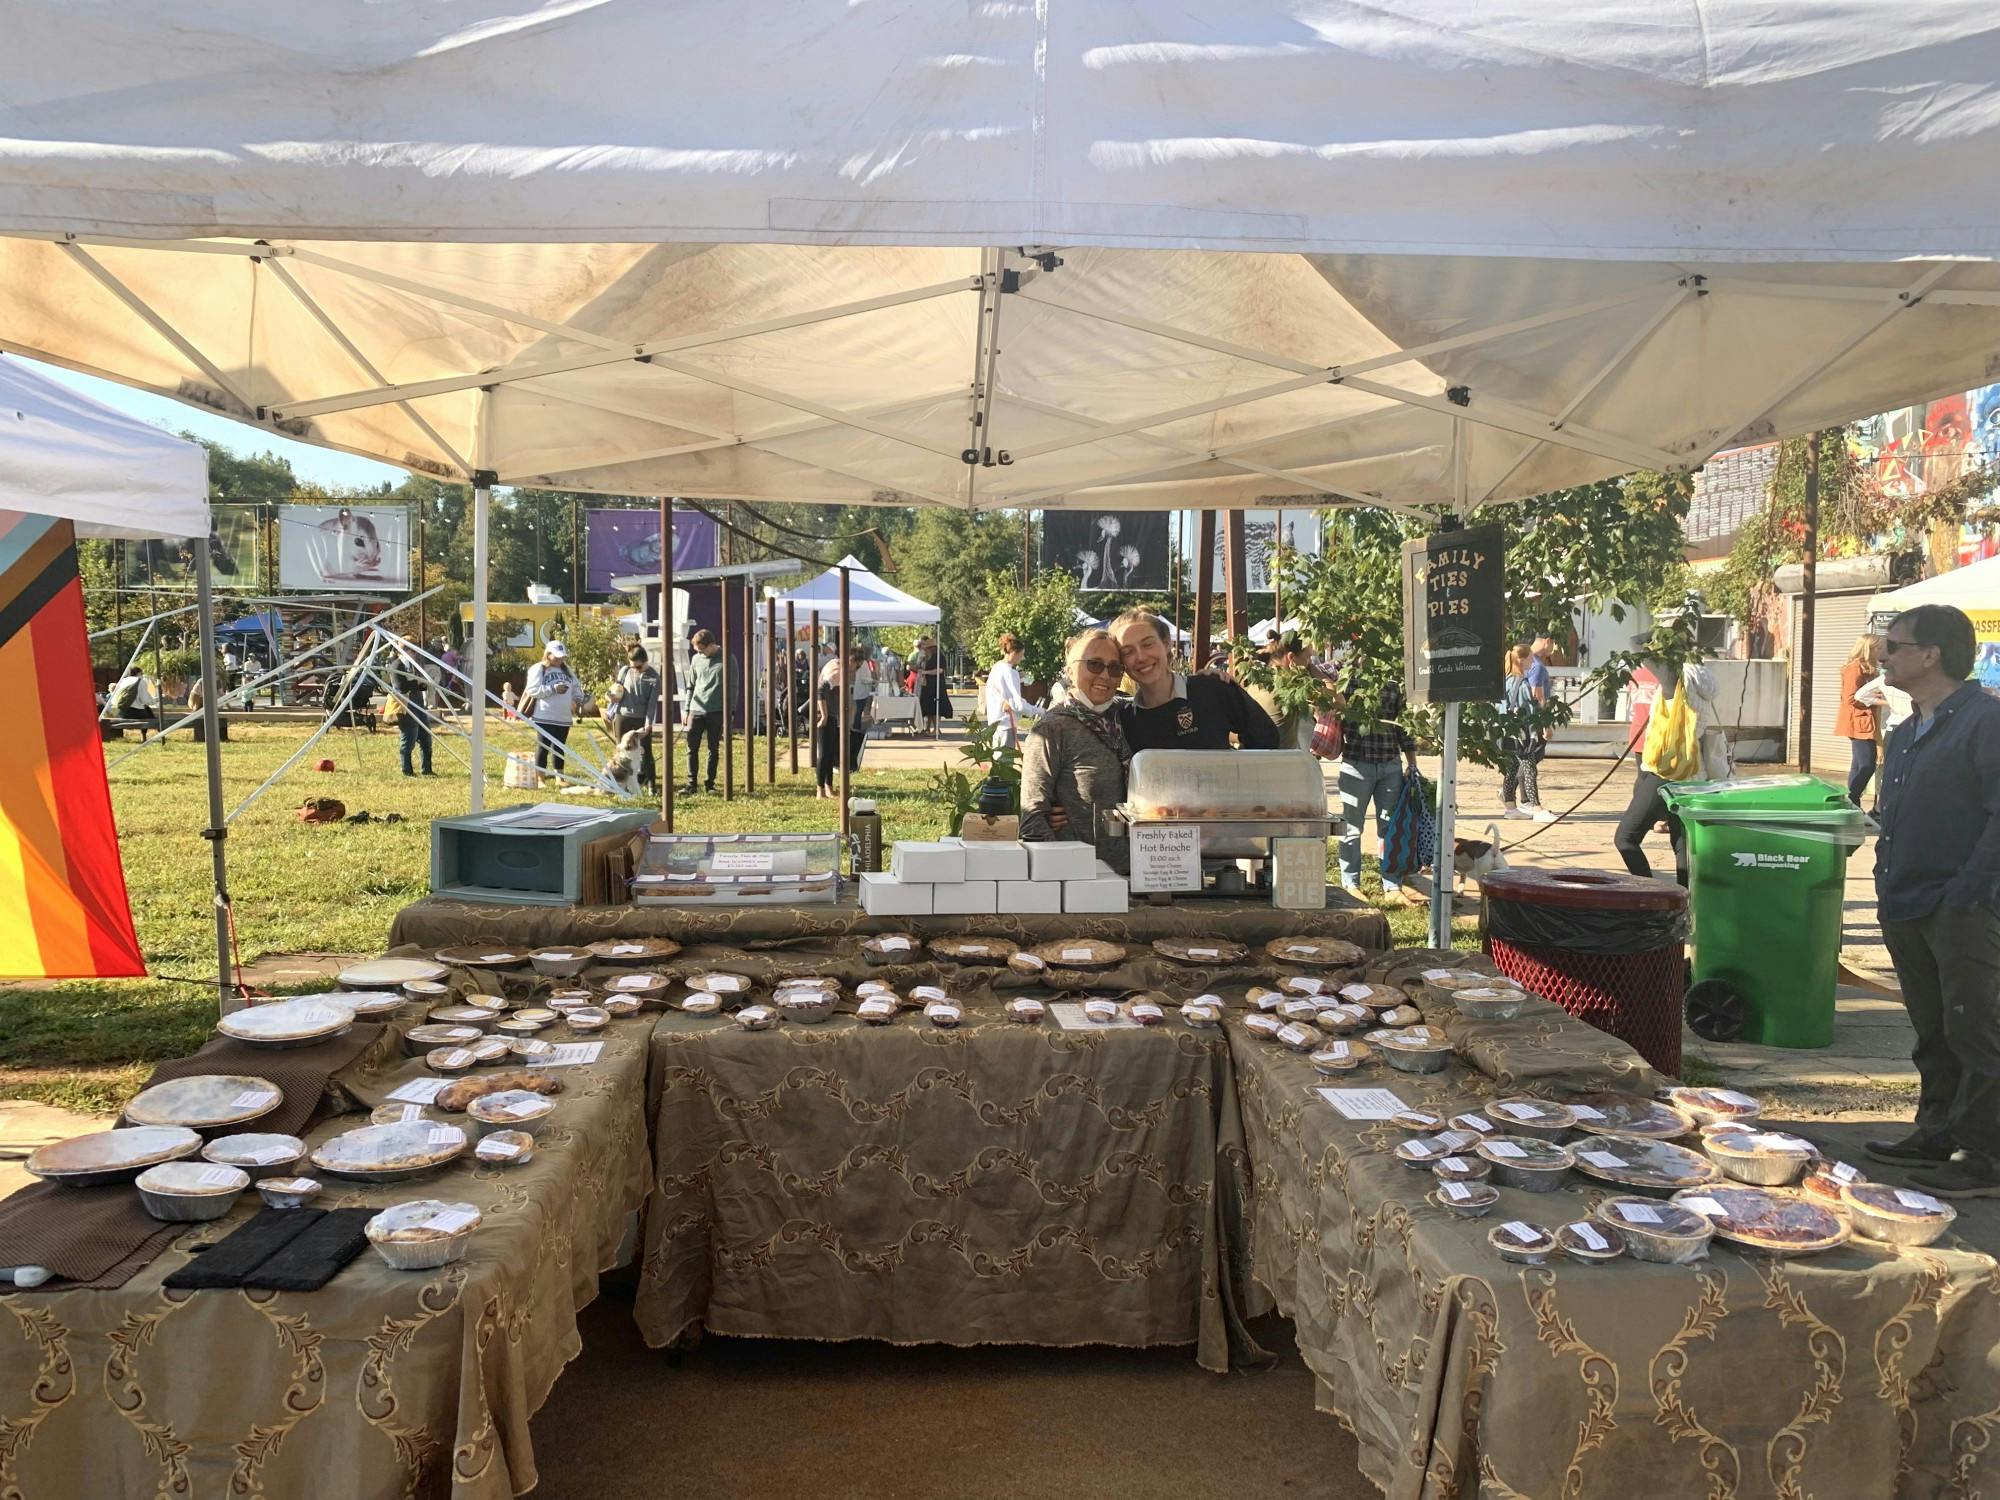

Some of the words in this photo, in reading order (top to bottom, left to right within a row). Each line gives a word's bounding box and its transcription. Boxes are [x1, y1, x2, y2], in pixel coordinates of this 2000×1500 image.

[1415, 549, 1485, 585] FAMILY
[1430, 570, 1468, 592] TIES
[1428, 598, 1470, 618] PIES
[1455, 660, 1481, 672] Welcome
[1137, 830, 1167, 841] Freshly
[1169, 829, 1193, 840] Baked
[1140, 843, 1158, 852] Hot
[1160, 842, 1191, 852] Brioche
[1283, 846, 1319, 866] EAT
[1757, 853, 1785, 863] Black
[1786, 853, 1811, 863] Bear
[1284, 869, 1319, 880] MORE
[1284, 881, 1319, 904] PIE
